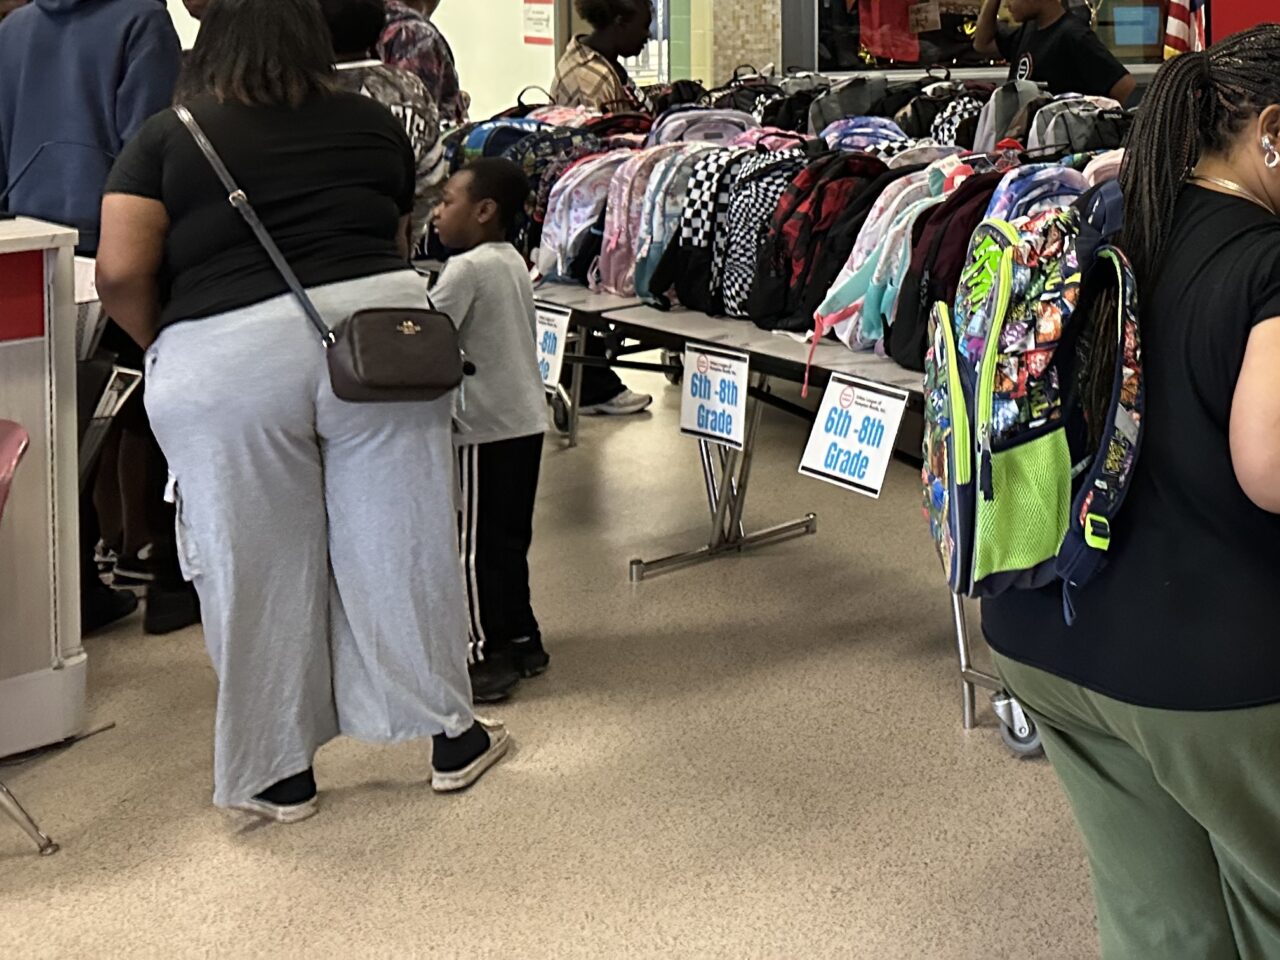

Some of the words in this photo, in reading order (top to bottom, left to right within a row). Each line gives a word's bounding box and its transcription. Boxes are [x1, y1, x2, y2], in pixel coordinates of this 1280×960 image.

[691, 372, 711, 400] 6th
[697, 403, 732, 435] Grade
[824, 406, 852, 438] 6th
[824, 441, 869, 480] Grade
